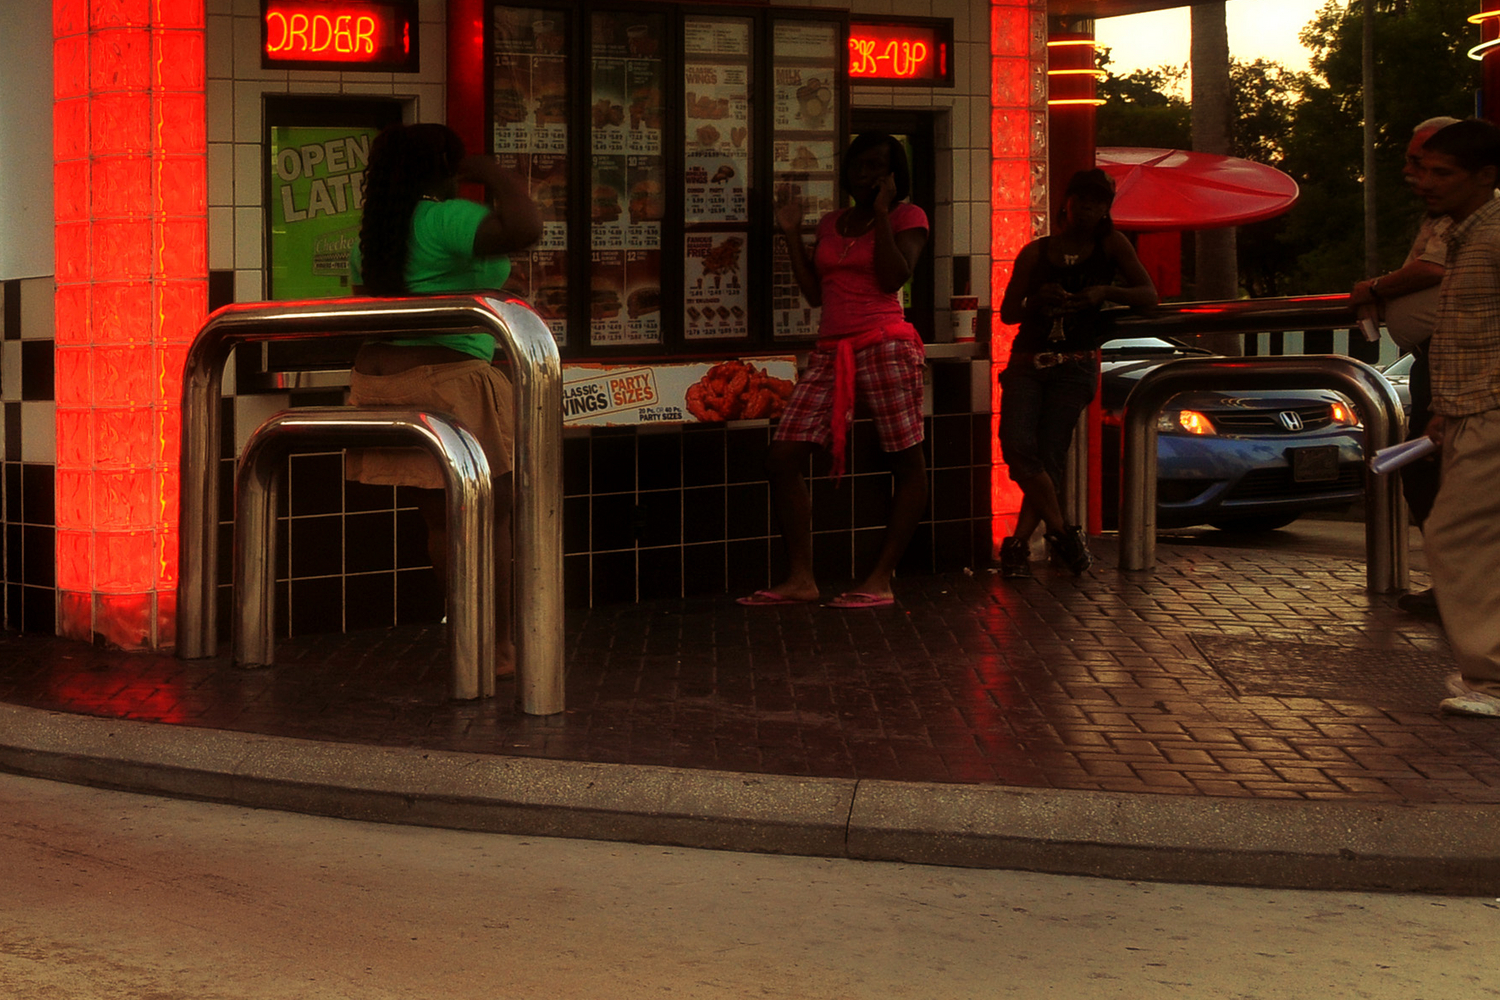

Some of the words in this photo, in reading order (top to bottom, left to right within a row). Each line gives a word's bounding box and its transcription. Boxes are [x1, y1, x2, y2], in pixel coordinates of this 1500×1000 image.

[686, 74, 717, 84] WINGS
[776, 69, 801, 80] MILK
[276, 134, 370, 182] OPEN
[316, 234, 354, 253] Checke
[687, 249, 712, 258] FRIES
[610, 374, 649, 392] PARTY
[614, 387, 653, 406] SIZES
